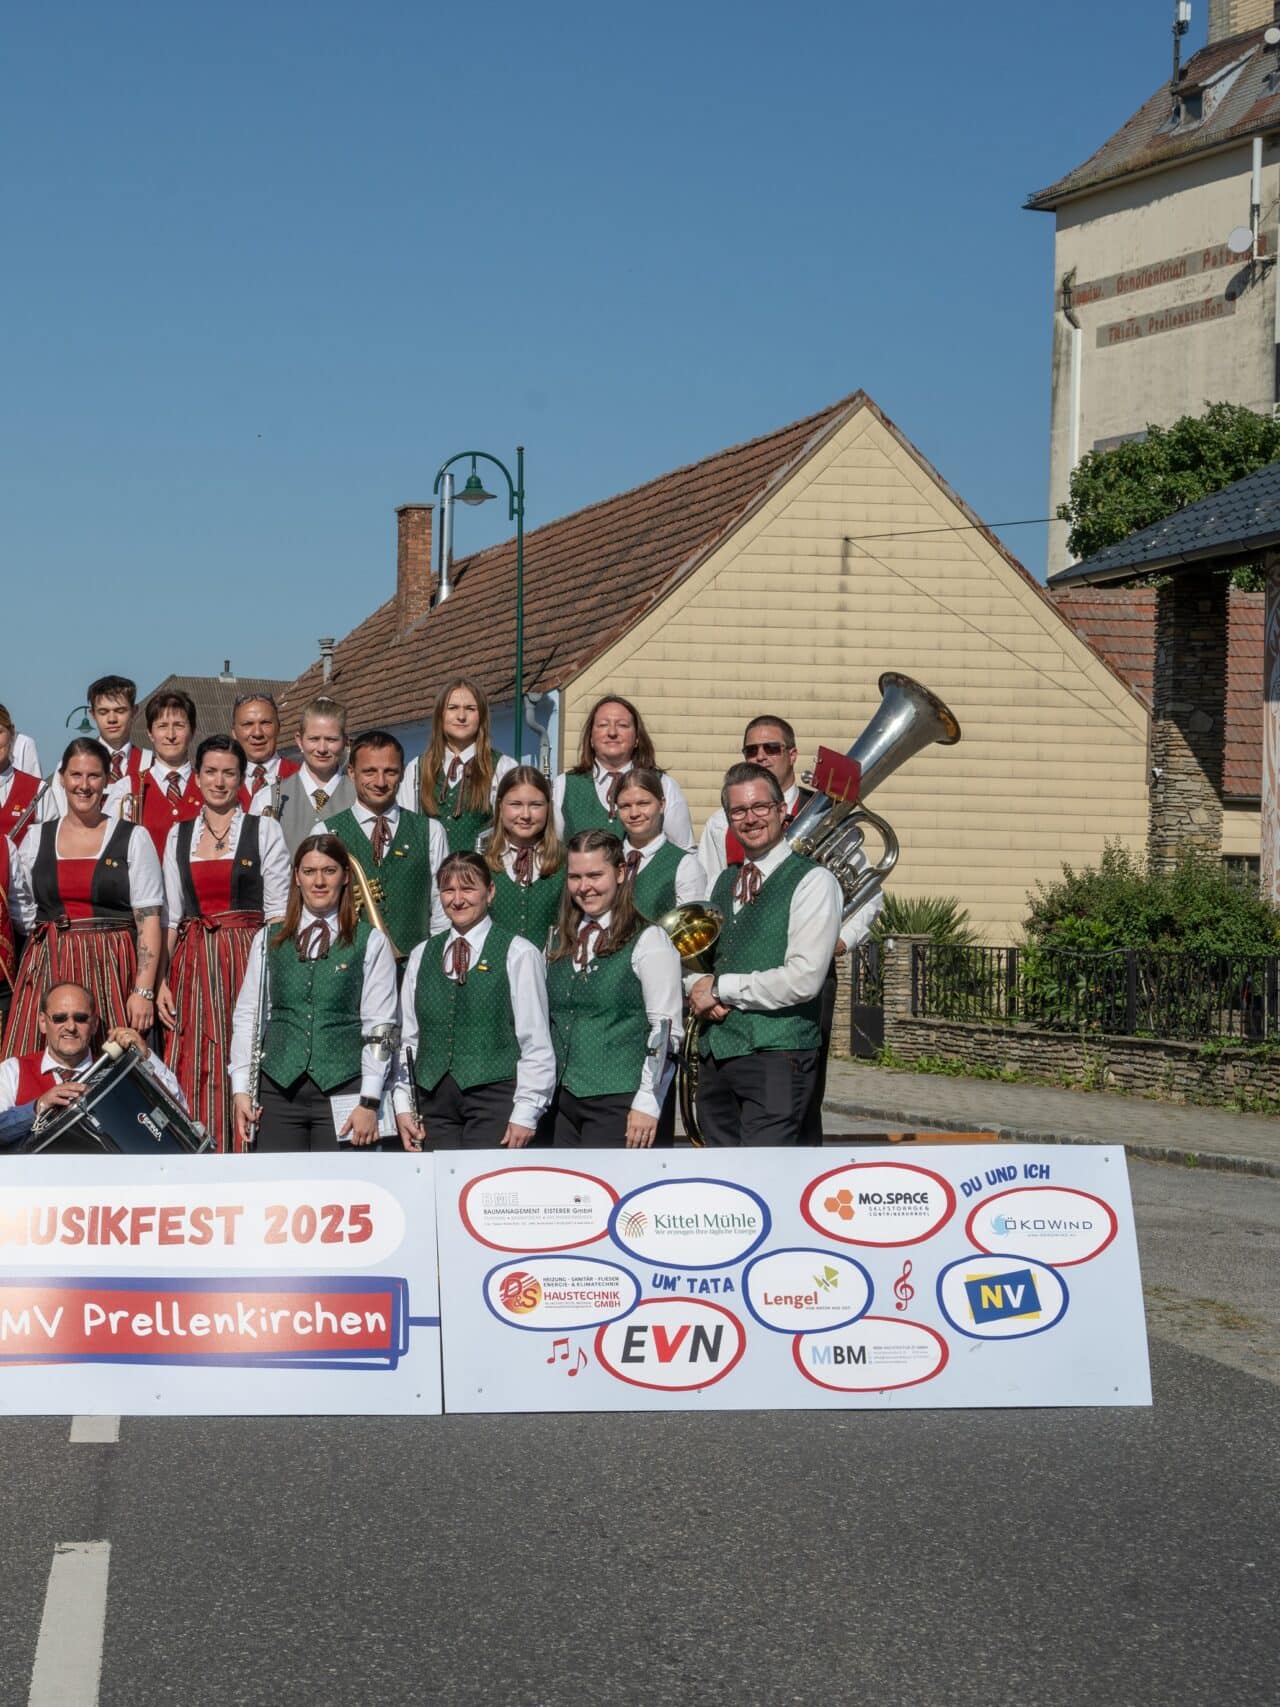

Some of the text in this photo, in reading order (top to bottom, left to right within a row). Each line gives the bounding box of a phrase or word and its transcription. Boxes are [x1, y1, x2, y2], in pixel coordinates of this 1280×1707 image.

[960, 1164, 1051, 1198] DU UND ICH
[858, 1192, 929, 1205] MO.SPACE
[263, 1204, 373, 1245] 2025
[654, 1212, 756, 1229] Kittel Mühle
[687, 1277, 735, 1294] TATA
[544, 1291, 620, 1301] HAUSTECHNIK
[594, 1300, 621, 1308] GMBH
[763, 1291, 819, 1309] Lengel
[980, 1284, 1025, 1310] NV
[1, 1305, 64, 1341] MV
[83, 1300, 387, 1339] Prellenkirchen
[620, 1324, 724, 1364] EVN
[811, 1345, 867, 1365] MBM
